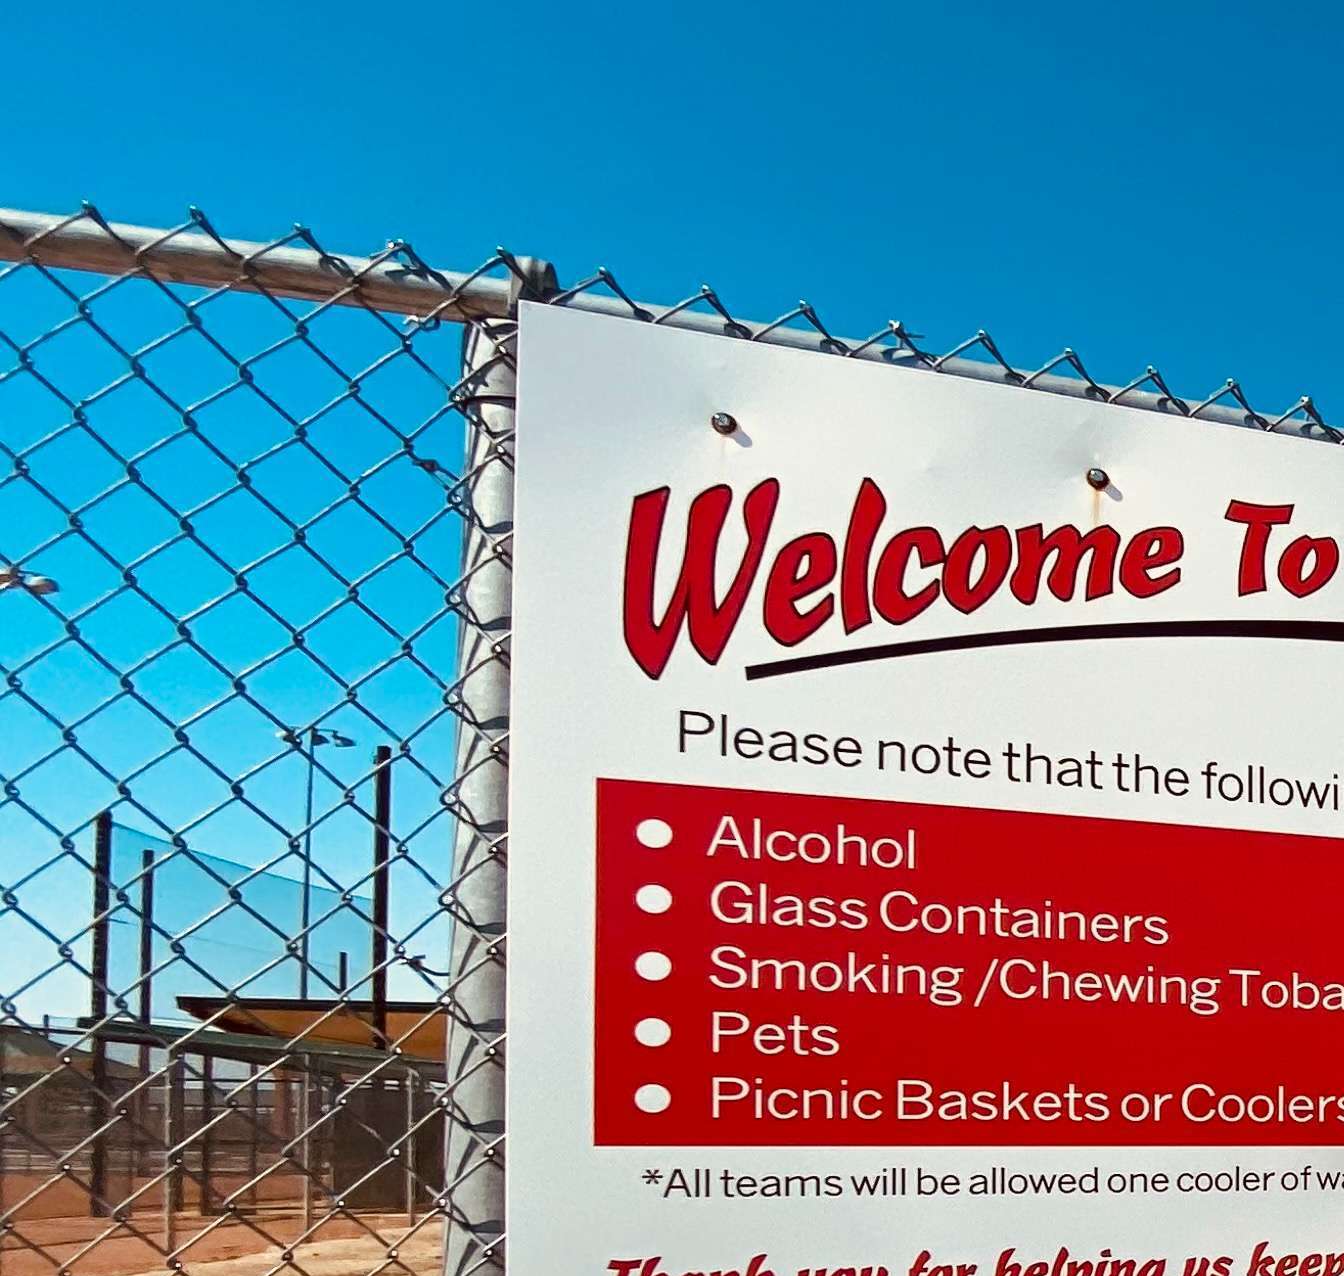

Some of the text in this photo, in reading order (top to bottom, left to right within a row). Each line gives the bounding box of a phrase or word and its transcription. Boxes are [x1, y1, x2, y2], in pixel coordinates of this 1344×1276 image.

[622, 477, 1185, 681] Welcome
[1224, 498, 1340, 599] To
[679, 709, 863, 768] Please
[878, 736, 992, 779] note
[1002, 742, 1104, 790] that
[1111, 753, 1190, 797] the
[706, 815, 915, 869] Alcohol
[710, 880, 1169, 945] Glass Containers
[709, 945, 965, 1006] Smoking
[974, 958, 1221, 1016] /Chewing
[712, 1011, 840, 1056] Pets
[712, 1076, 883, 1120] Picnic
[897, 1079, 1110, 1122] Baskets
[1121, 1093, 1173, 1122] or
[719, 1169, 843, 1198] teams
[850, 1167, 906, 1196] will
[917, 1167, 961, 1196] be
[968, 1166, 1099, 1195] allowed
[1107, 1172, 1170, 1194] one
[1176, 1165, 1276, 1193] cooler
[1280, 1165, 1312, 1191] of
